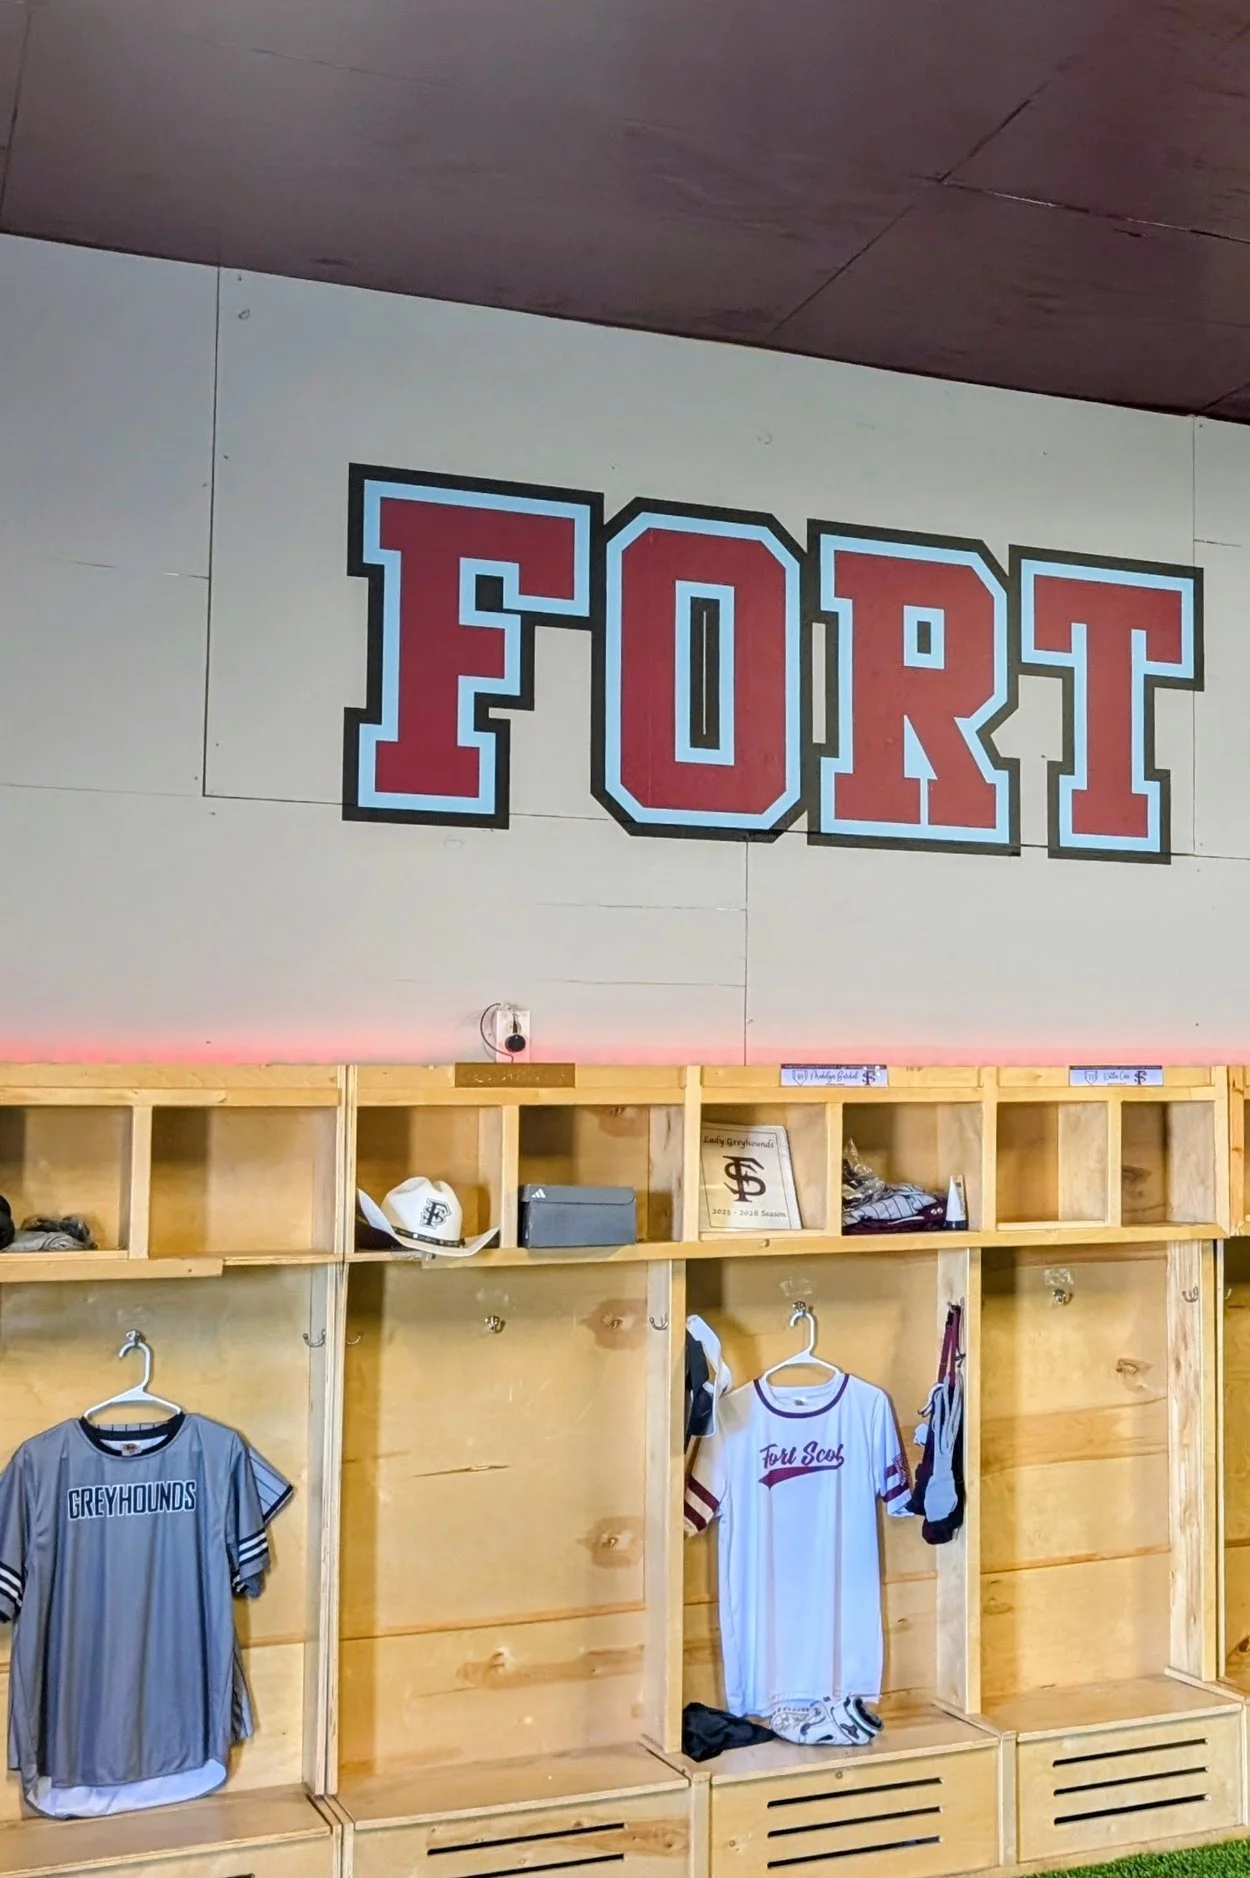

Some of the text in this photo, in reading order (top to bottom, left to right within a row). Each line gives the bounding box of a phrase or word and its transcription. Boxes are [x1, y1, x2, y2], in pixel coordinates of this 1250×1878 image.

[342, 463, 1203, 865] FORT
[703, 1136, 774, 1149] Lady Greyhounds
[761, 1210, 787, 1218] Season
[68, 1479, 197, 1520] GREYHOUNDS
